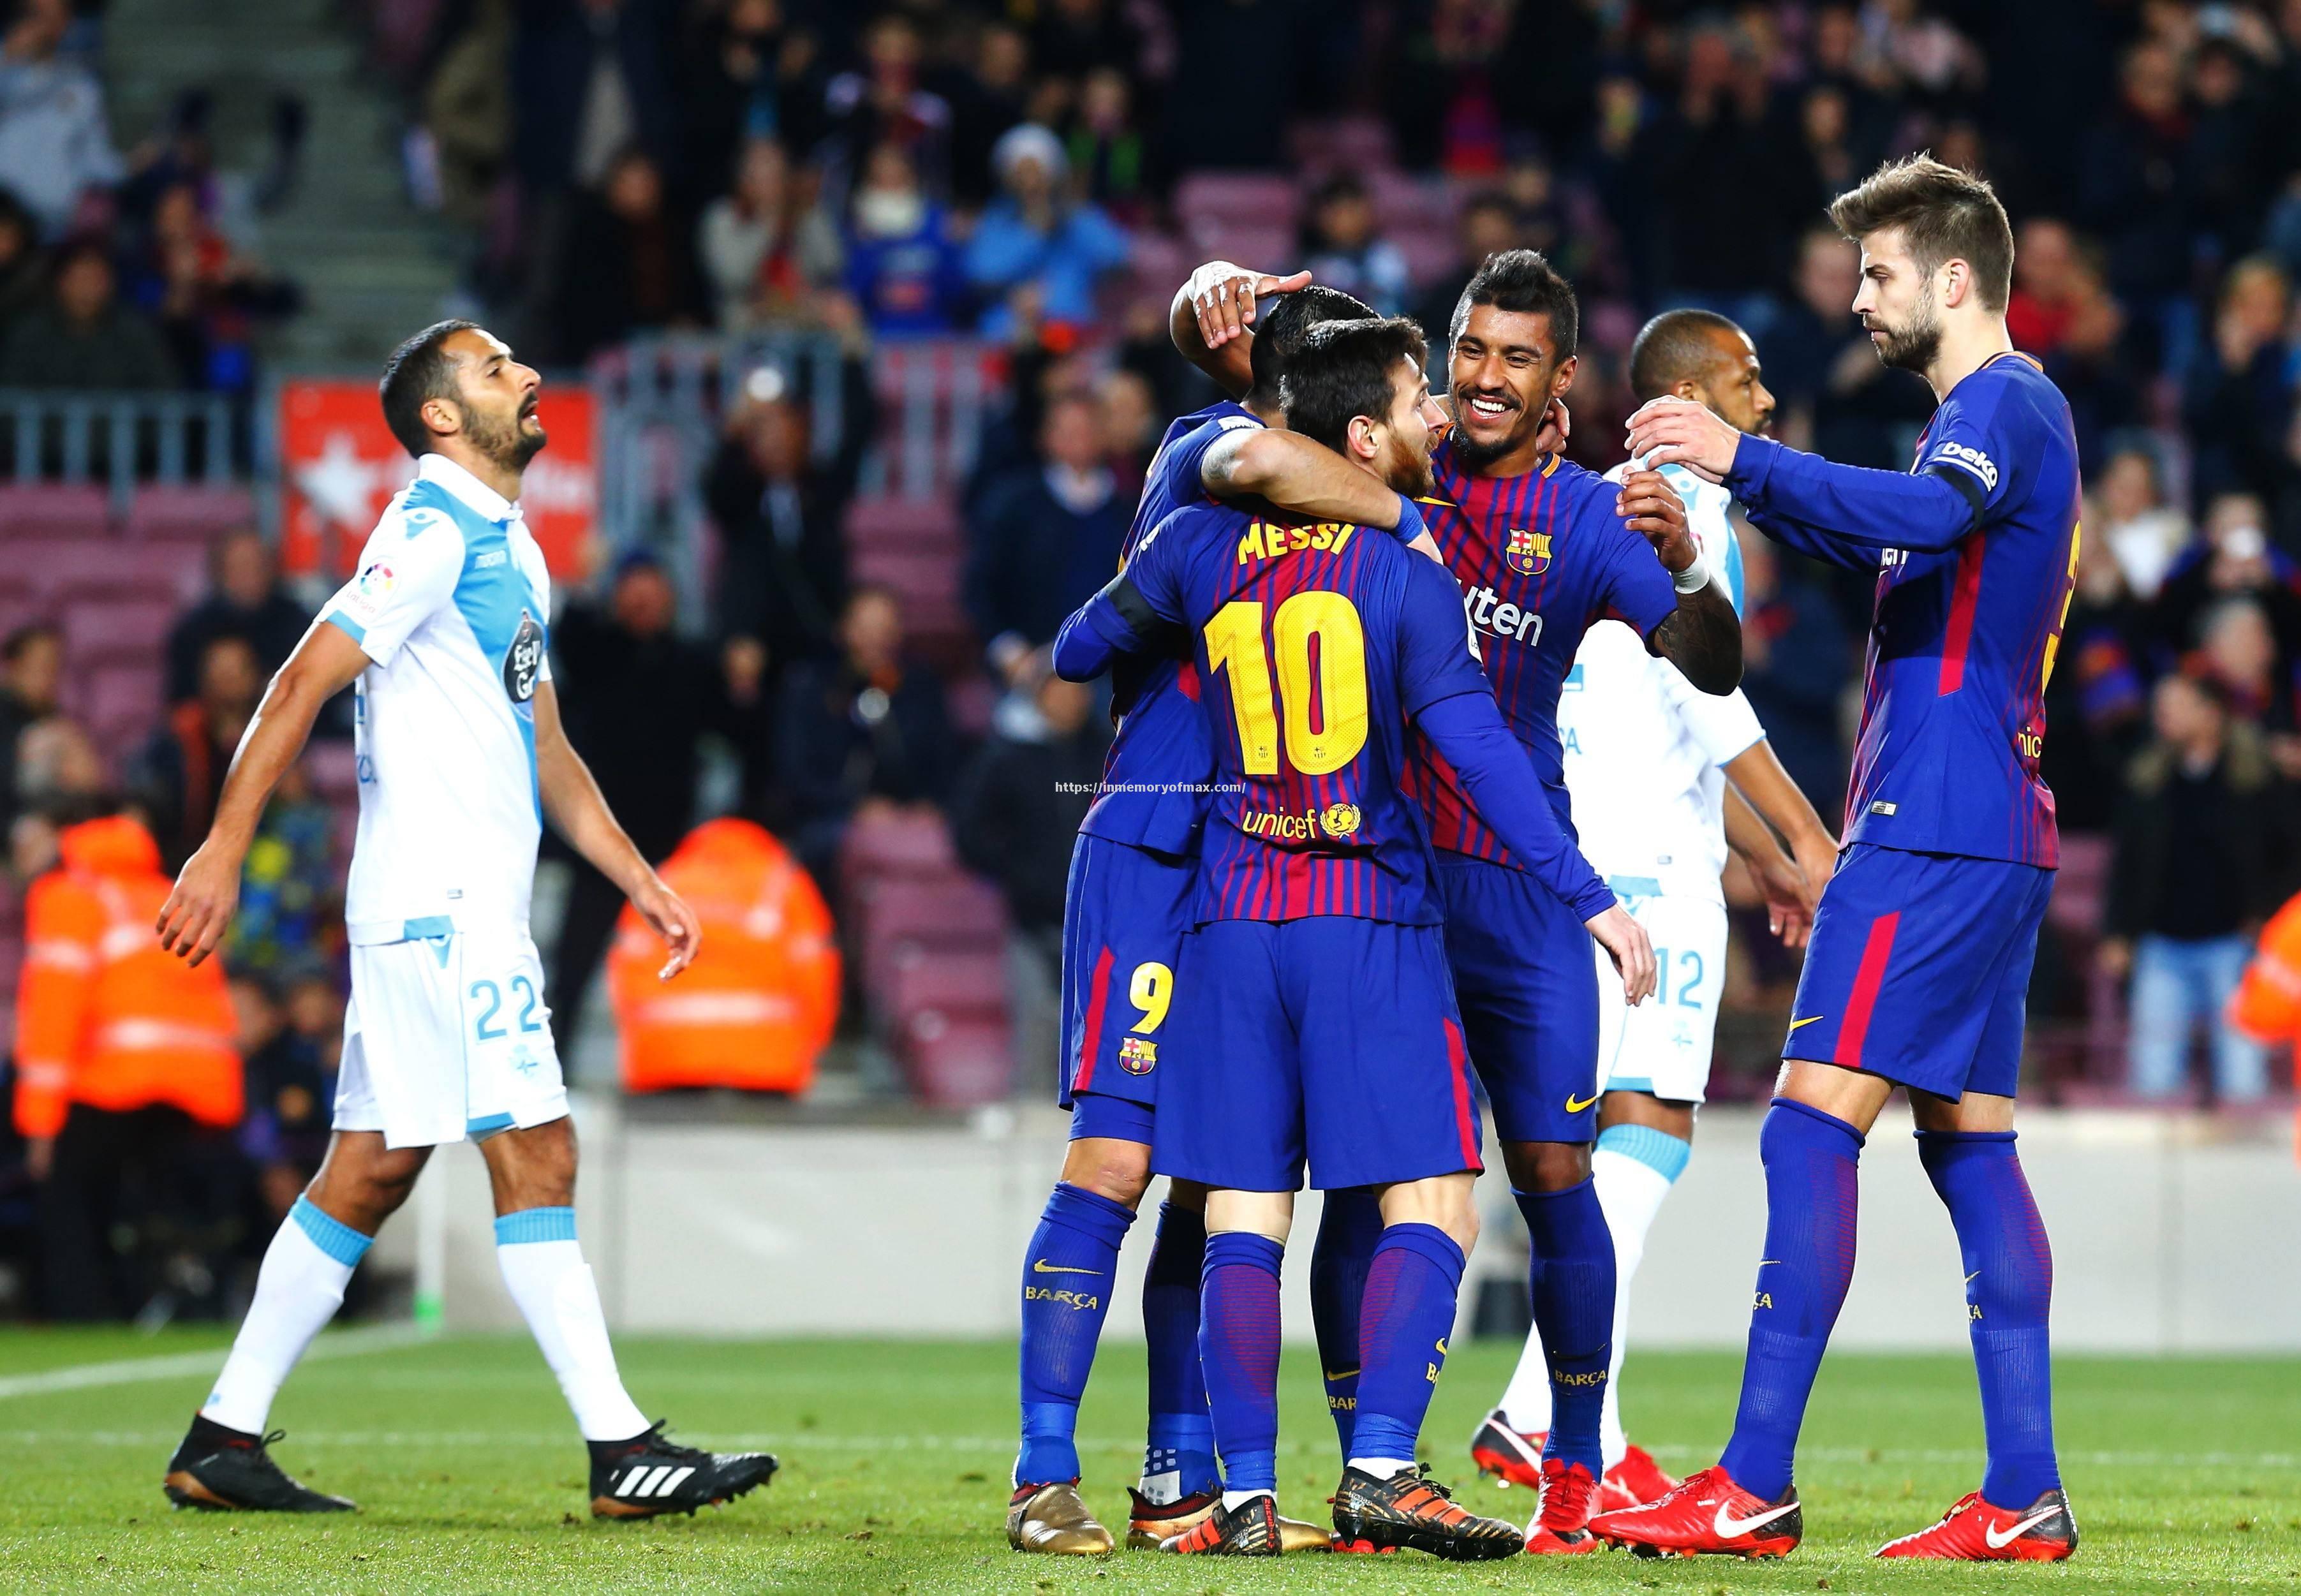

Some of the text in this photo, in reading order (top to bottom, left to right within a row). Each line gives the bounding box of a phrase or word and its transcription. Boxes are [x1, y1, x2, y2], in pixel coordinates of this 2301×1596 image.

[1941, 441, 1998, 487] beko
[1238, 522, 1355, 565] MESSI
[1203, 591, 1368, 775] 10
[1242, 806, 1317, 839] unicef
[1128, 961, 1174, 1035] 9
[1654, 948, 1703, 1009] 12
[471, 975, 542, 1040] 22
[1026, 1286, 1098, 1310] BARÇA
[1555, 1370, 1606, 1387] BARÇA
